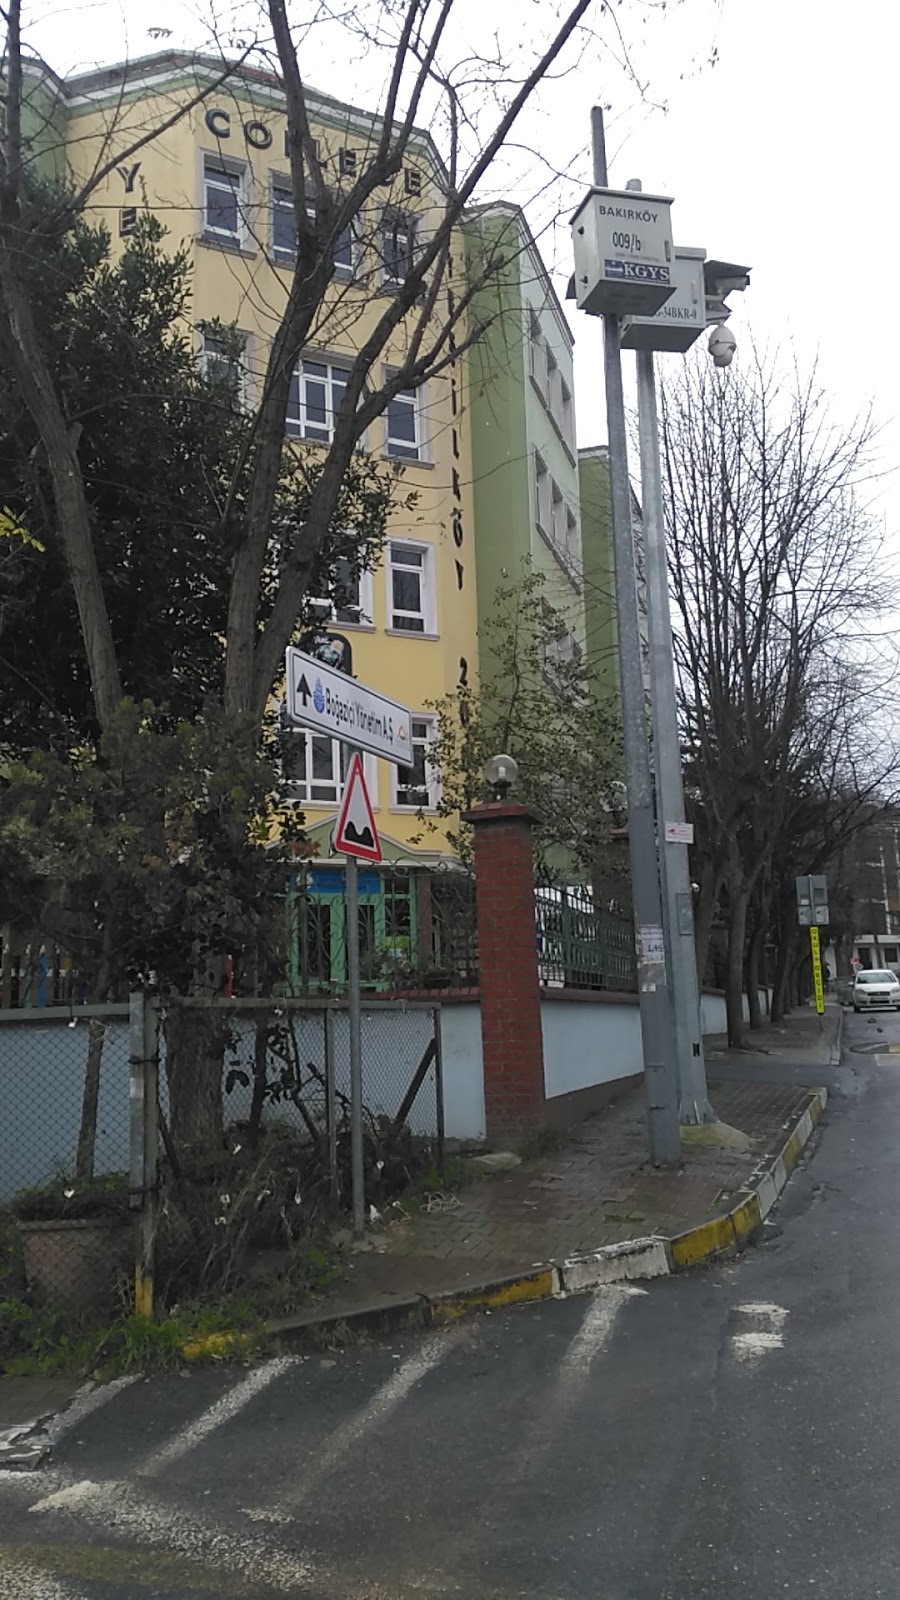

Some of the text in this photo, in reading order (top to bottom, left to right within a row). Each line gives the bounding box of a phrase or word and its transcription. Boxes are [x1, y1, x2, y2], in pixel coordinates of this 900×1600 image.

[599, 206, 658, 223] BAKIRKÖY
[624, 264, 669, 281] KGYS
[325, 687, 355, 728] Boğaziçi
